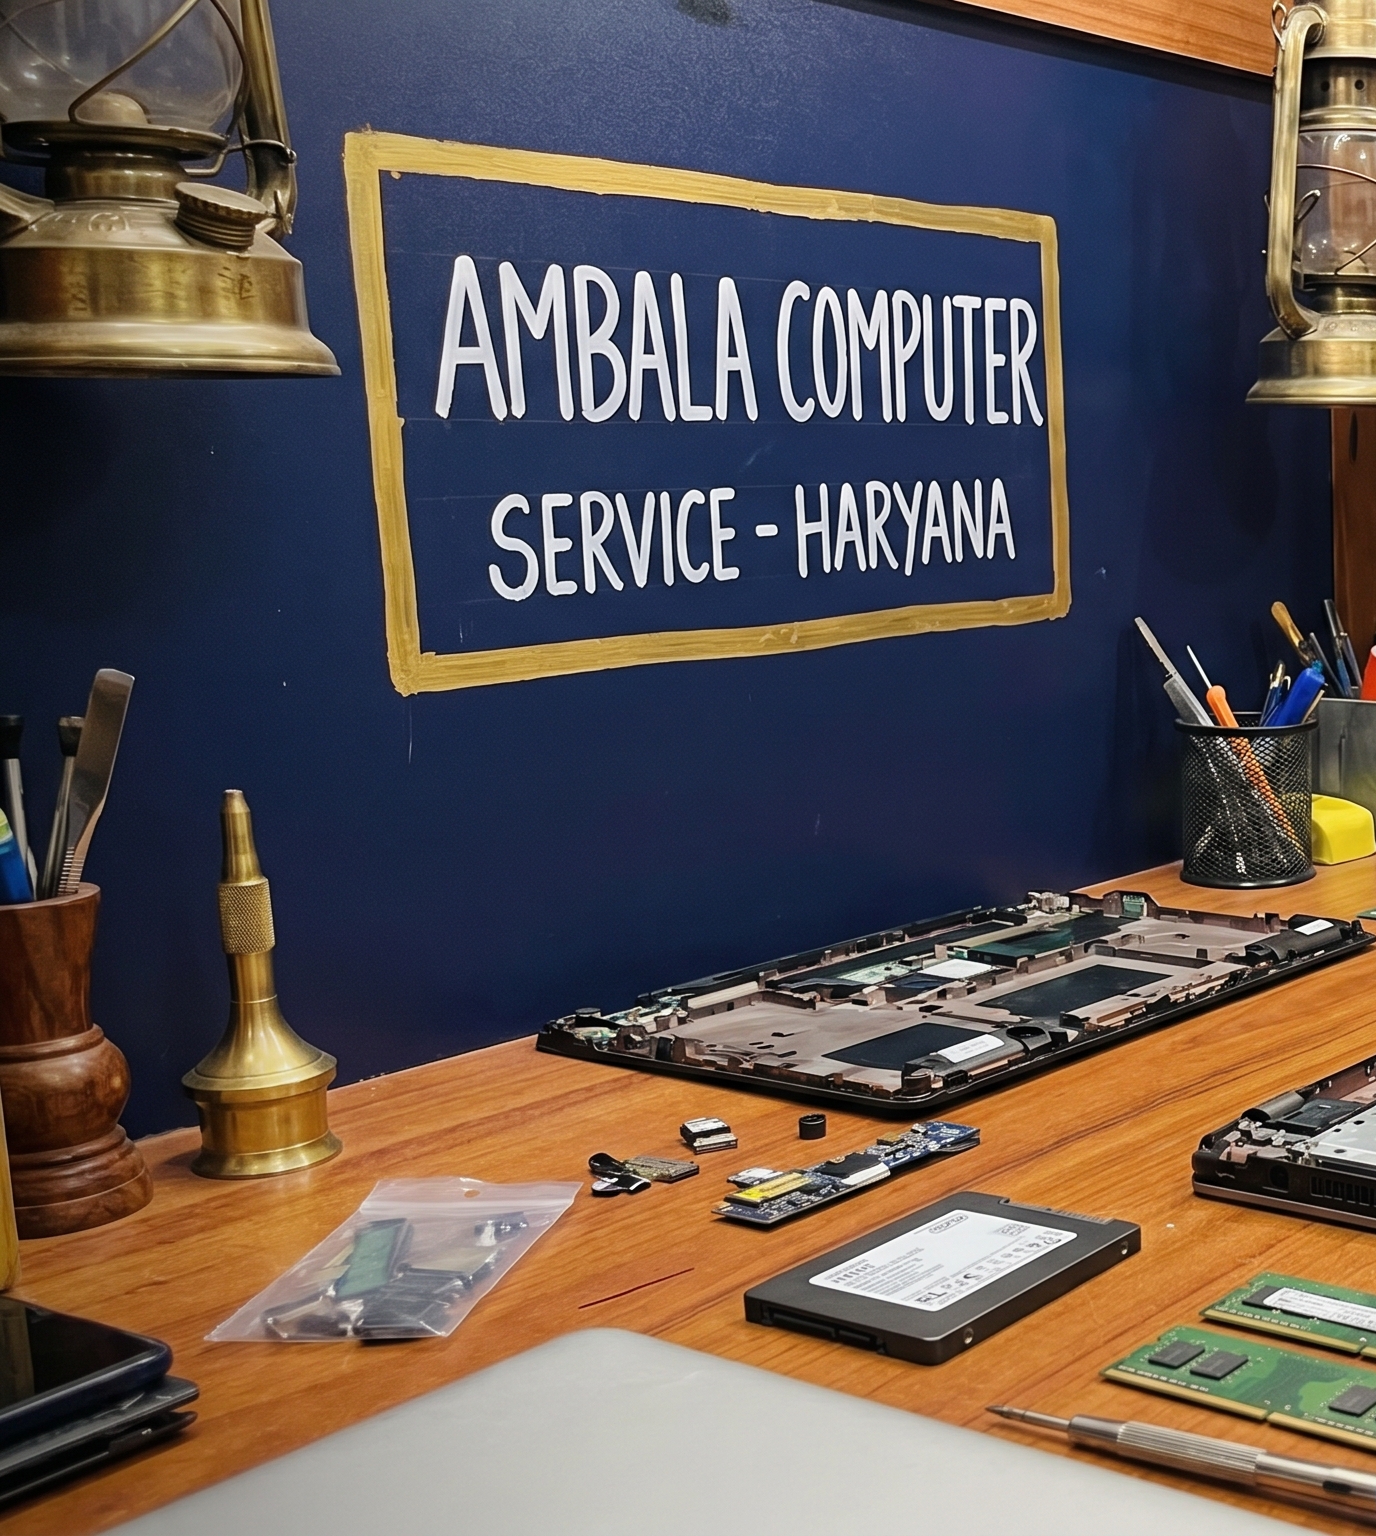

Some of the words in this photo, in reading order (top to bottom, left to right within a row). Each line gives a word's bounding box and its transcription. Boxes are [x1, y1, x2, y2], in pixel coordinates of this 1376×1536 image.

[434, 254, 759, 423] AMBALA
[776, 279, 1044, 427] COMPUTER
[488, 487, 740, 602] SERVICE
[755, 524, 779, 537] -
[794, 477, 1016, 579] HARYANA
